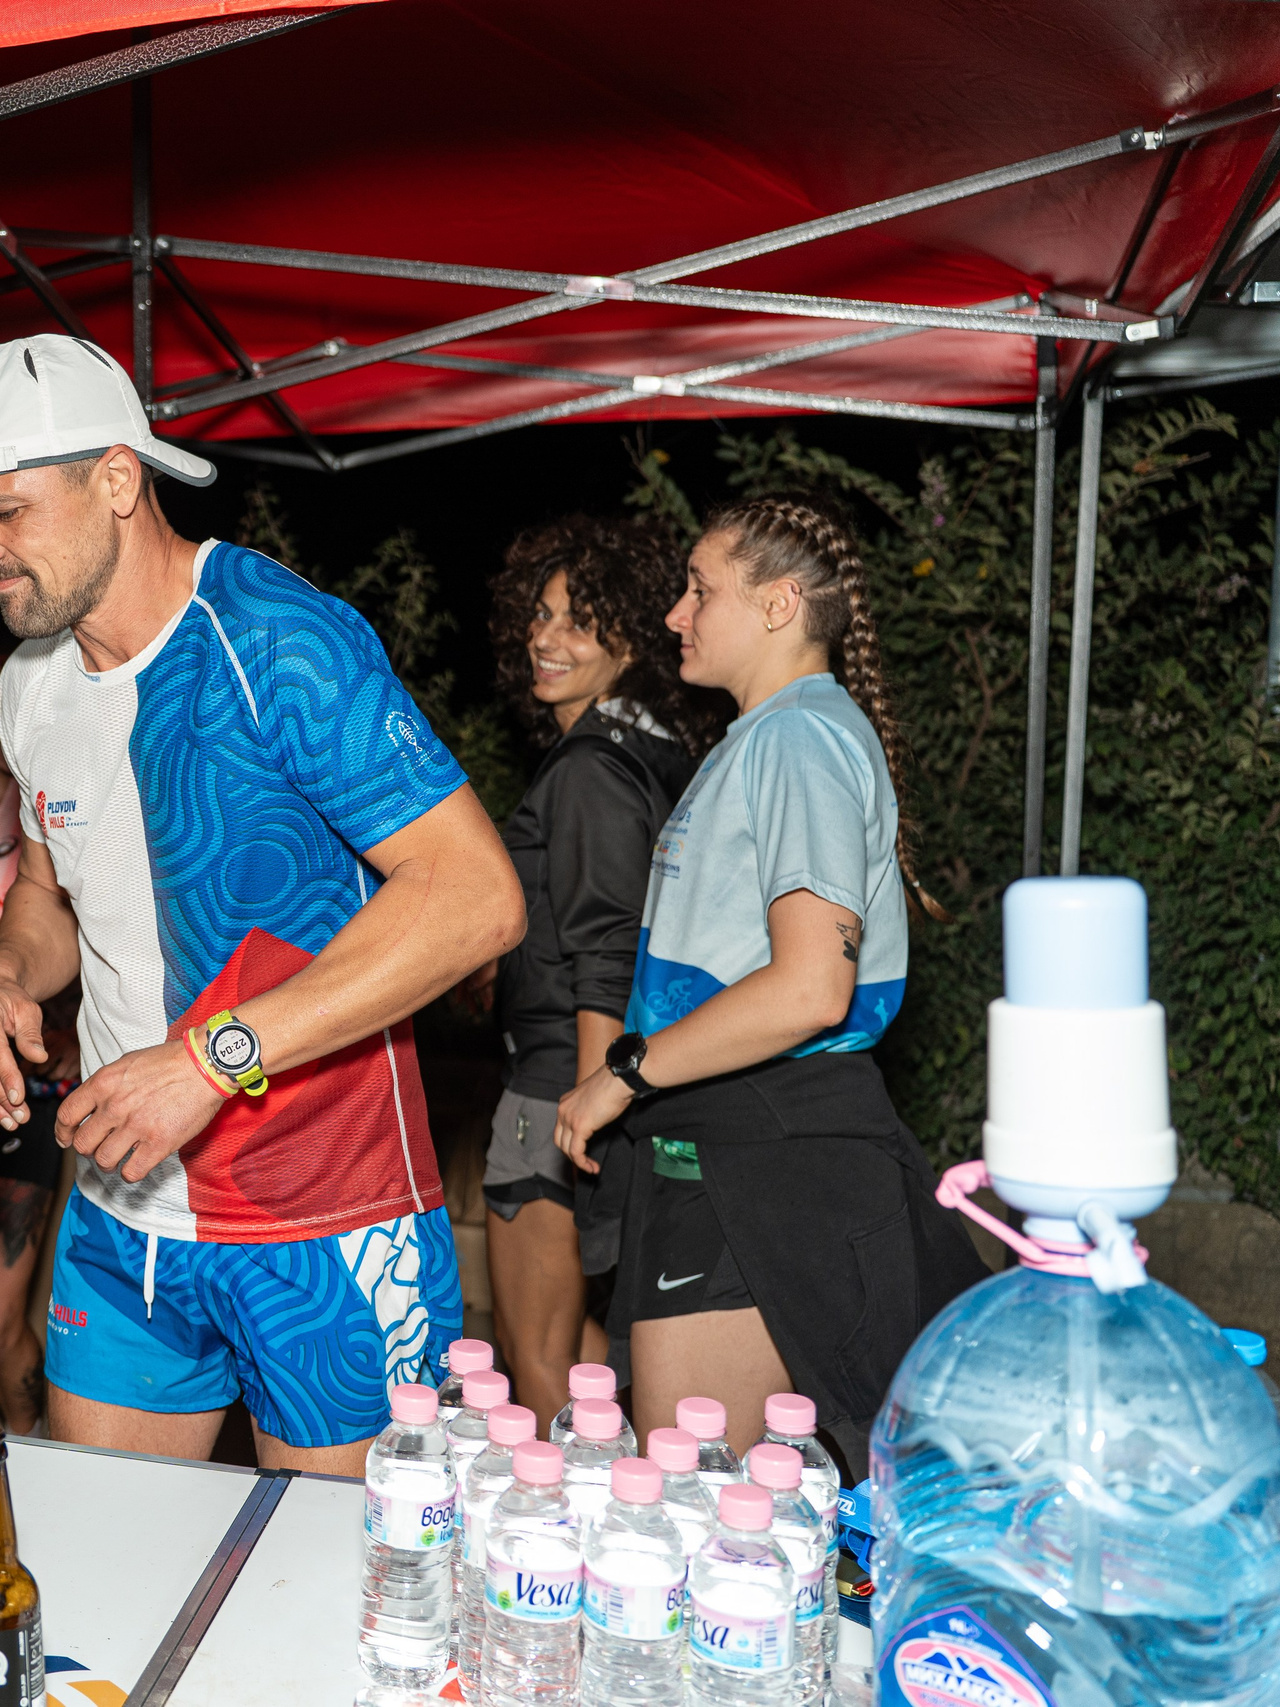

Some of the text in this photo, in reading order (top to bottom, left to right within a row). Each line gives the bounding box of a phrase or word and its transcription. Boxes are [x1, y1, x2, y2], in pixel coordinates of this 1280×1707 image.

[47, 800, 77, 814] PLOVDIV
[49, 816, 65, 829] HILLS
[220, 1038, 247, 1057] 22:04
[55, 1303, 88, 1328] HILLS
[516, 1571, 574, 1608] Vesa
[692, 1614, 730, 1649] esa
